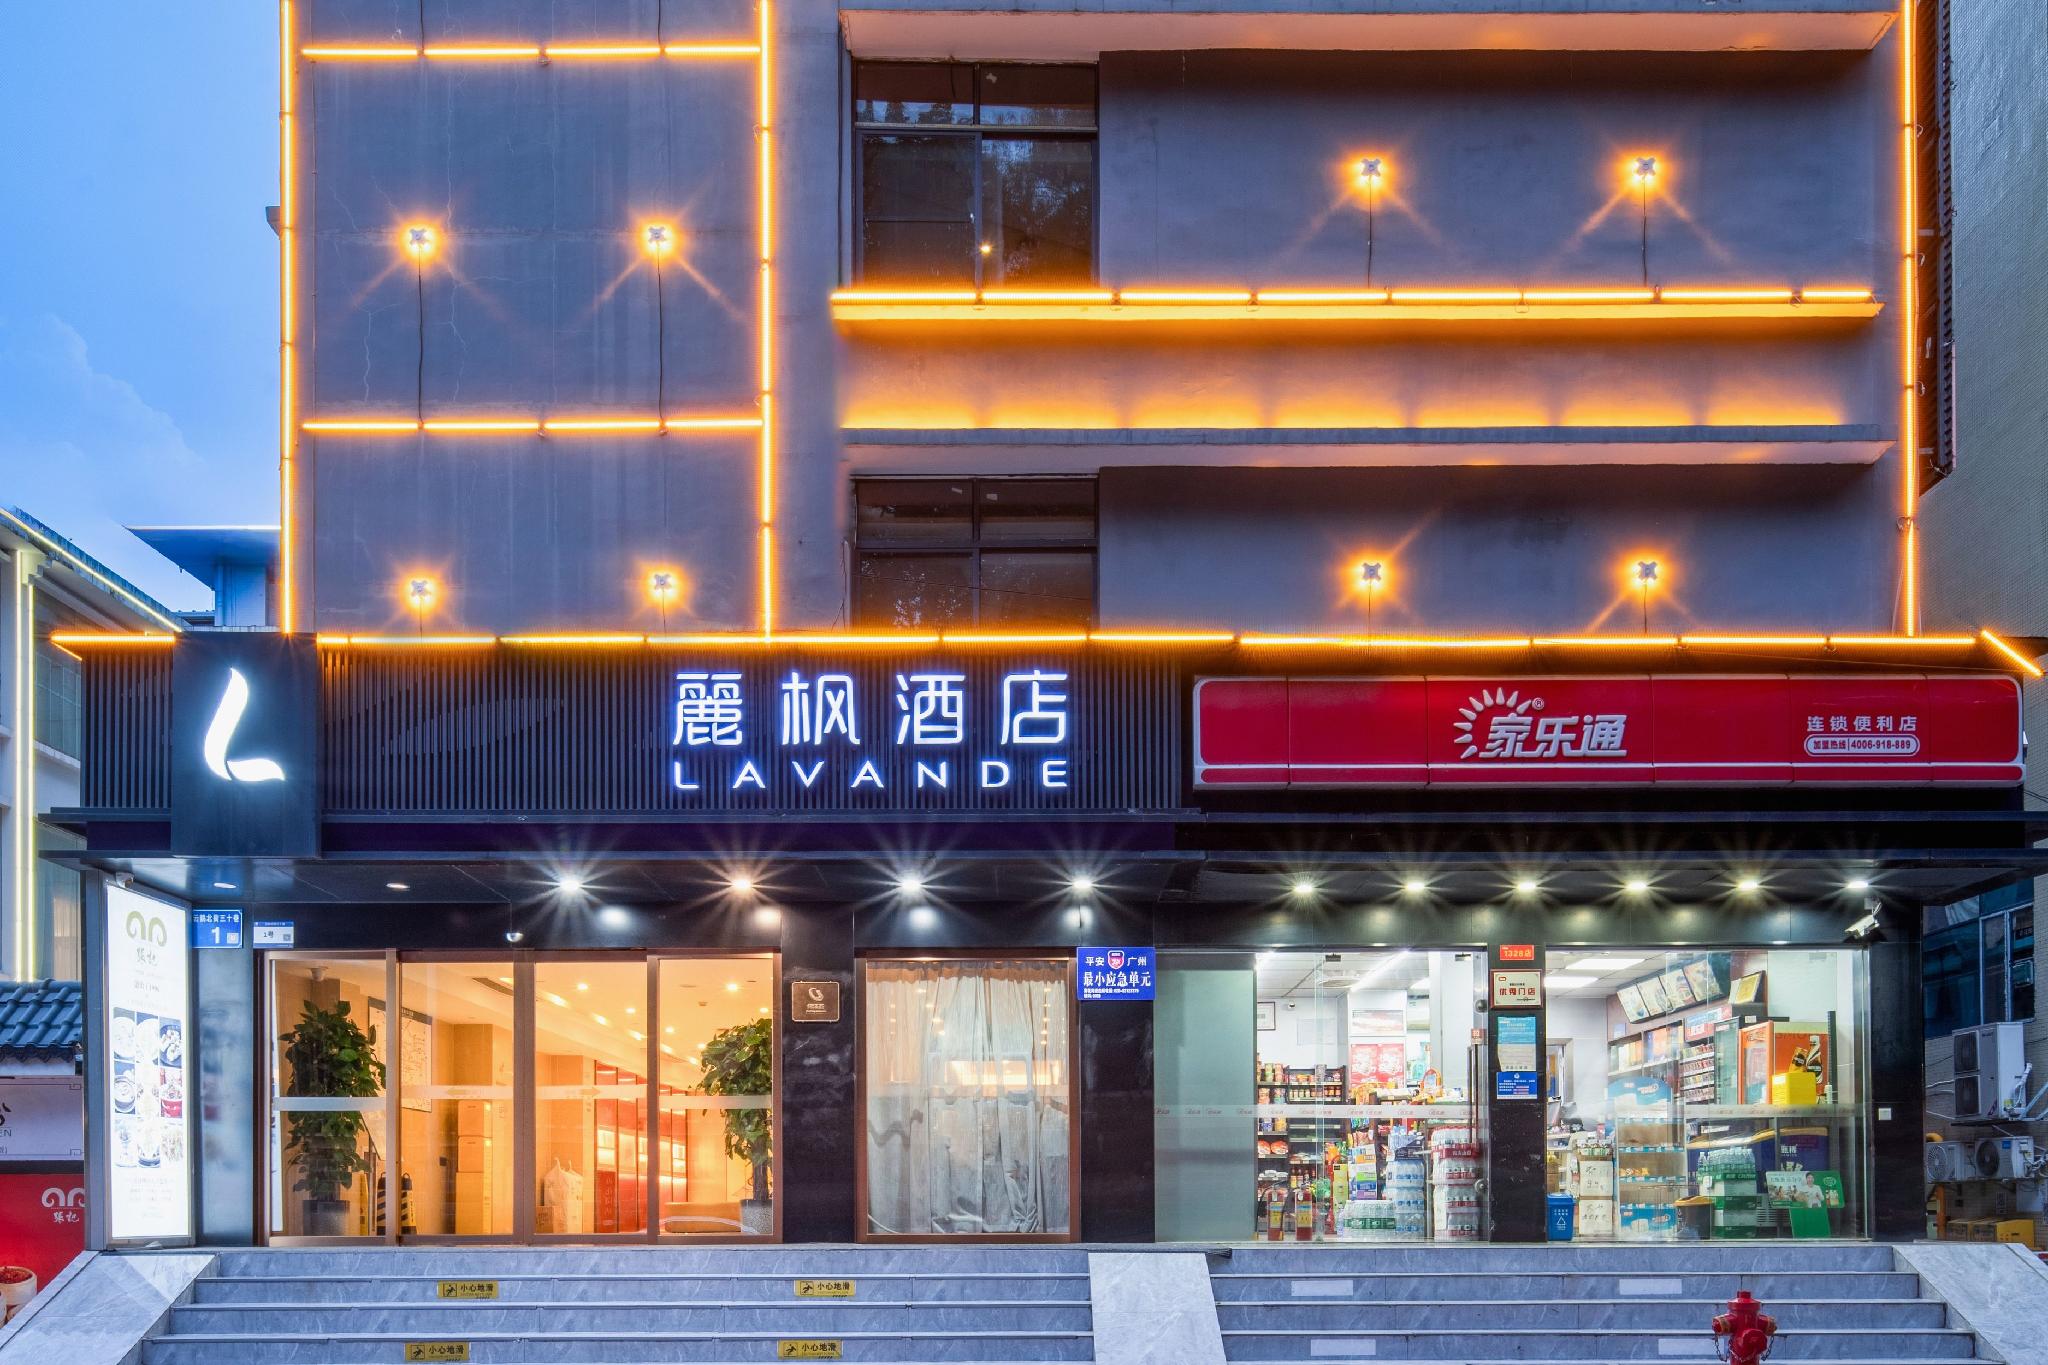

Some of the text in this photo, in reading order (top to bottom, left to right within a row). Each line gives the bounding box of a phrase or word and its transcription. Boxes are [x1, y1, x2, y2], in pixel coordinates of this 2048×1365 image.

[672, 669, 1068, 745] 麗枫酒店
[1806, 715, 1918, 732] 连锁便利店
[1479, 712, 1628, 758] 家乐通
[1813, 739, 1911, 750] 加盟热线 4006-918-889
[673, 759, 1068, 789] LAVANDE
[211, 926, 220, 944] 1
[1085, 956, 1147, 967] 平安 广州
[1083, 970, 1152, 987] 最小应急单元
[460, 1283, 494, 1292] 小心地滑
[817, 1281, 850, 1291] 小心地滑
[428, 1344, 465, 1355] 小心地滑
[801, 1342, 837, 1352] 小心地滑
